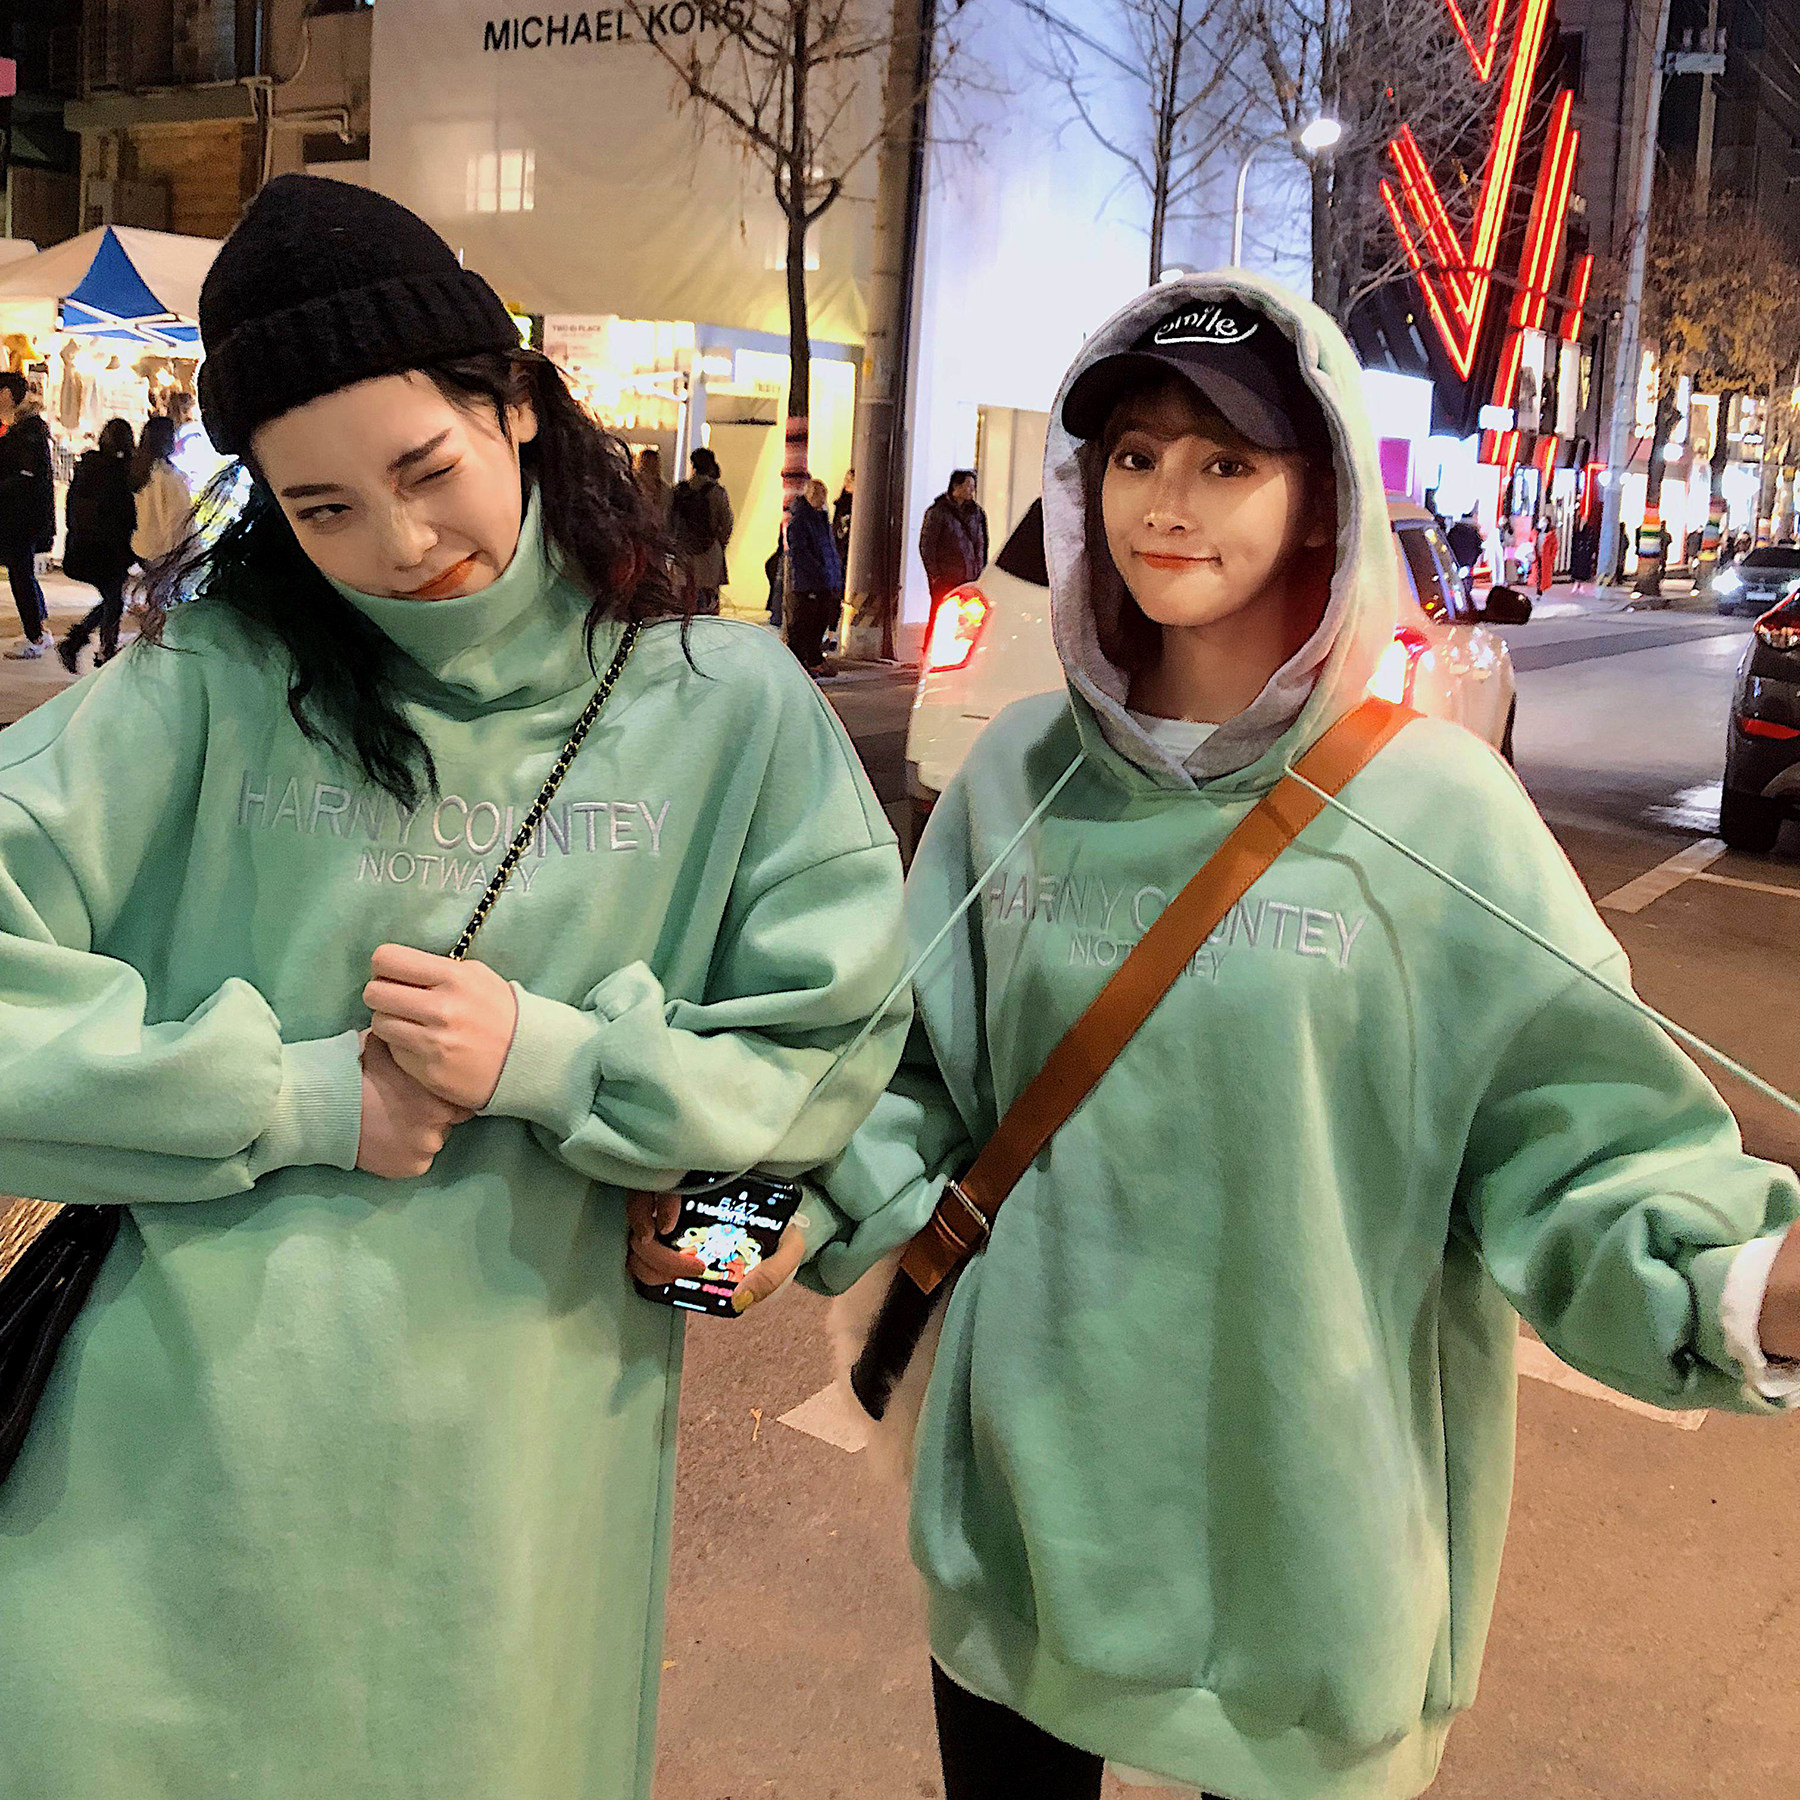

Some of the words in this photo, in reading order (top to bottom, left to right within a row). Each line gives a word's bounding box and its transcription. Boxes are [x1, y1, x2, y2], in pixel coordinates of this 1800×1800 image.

[484, 9, 632, 51] MICHAEL
[647, 0, 744, 35] KORS
[237, 769, 430, 846] HARNY
[355, 847, 545, 894] NOTWAY
[1130, 884, 1368, 970] CNTEY
